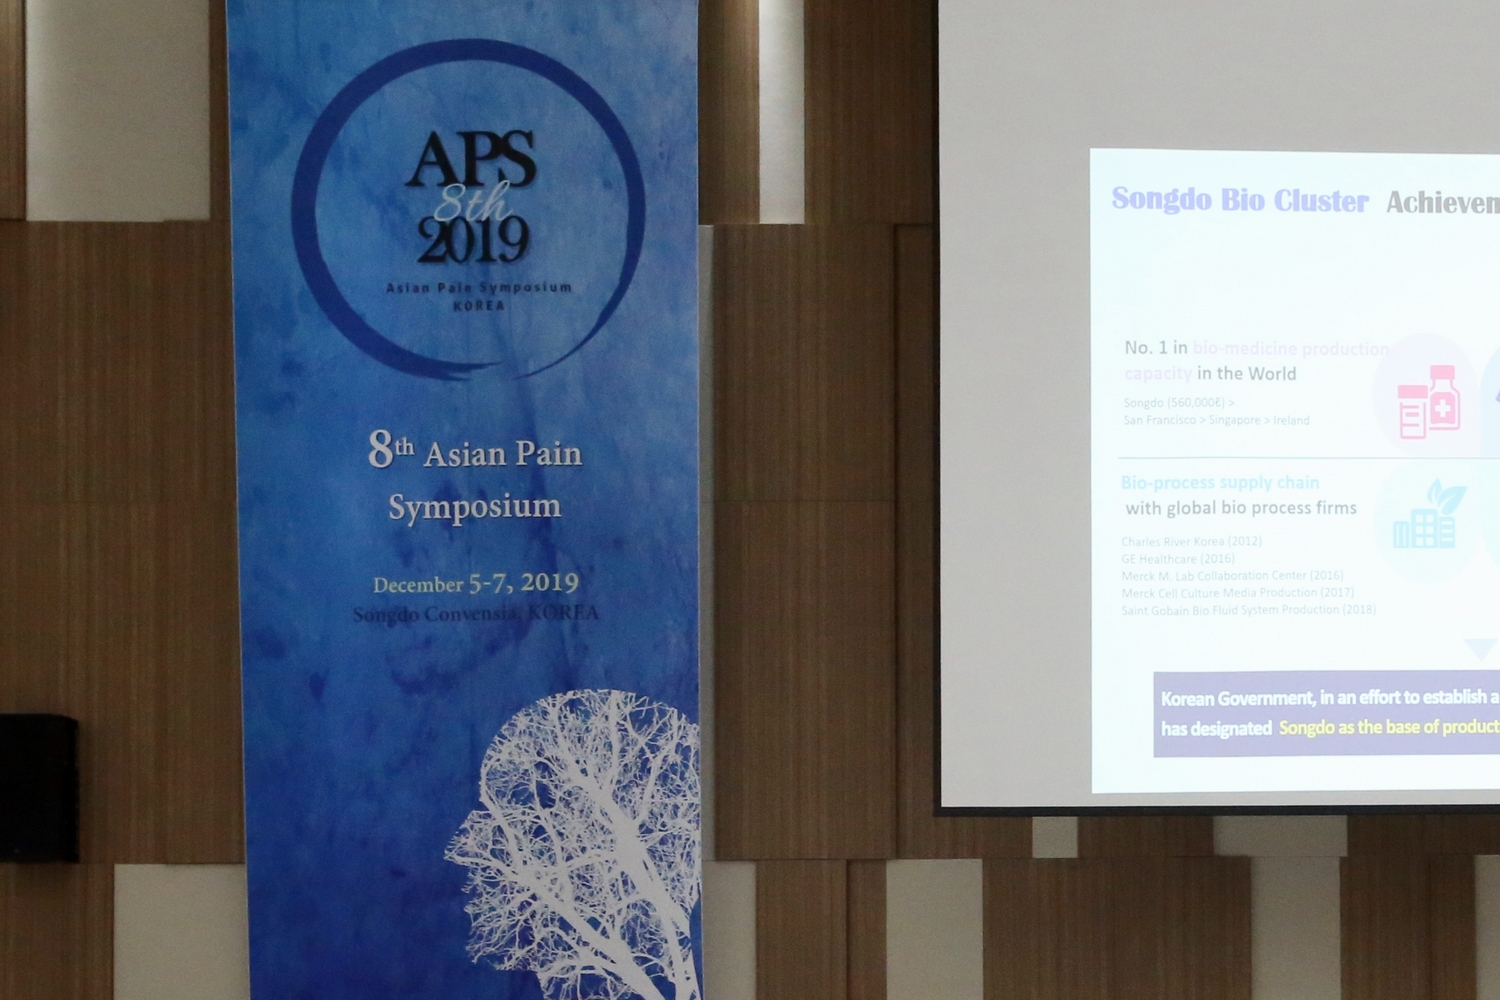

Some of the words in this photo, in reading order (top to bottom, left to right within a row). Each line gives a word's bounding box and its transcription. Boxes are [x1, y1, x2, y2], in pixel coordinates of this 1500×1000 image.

[405, 129, 537, 188] APS
[433, 180, 513, 222] 8th
[1112, 186, 1212, 215] Songdo
[1222, 188, 1265, 211] Bio
[1274, 188, 1370, 212] Cluster
[417, 215, 530, 264] 2019
[386, 282, 430, 294] Asian
[437, 282, 472, 294] Pain
[479, 281, 572, 297] Symposium
[453, 301, 506, 312] KOREA
[1125, 340, 1153, 355] No.
[1159, 339, 1168, 355] 1
[1173, 339, 1188, 355] in
[1193, 340, 1297, 355] bio-medicine
[1302, 342, 1390, 358] production
[1125, 365, 1192, 383] capacity
[1197, 364, 1212, 380] in
[1216, 364, 1244, 381] the
[1248, 366, 1298, 381] World
[368, 429, 415, 469] 8th
[423, 441, 506, 468] Asian
[516, 440, 583, 466] Pain
[1122, 475, 1215, 493] Bio-process
[1220, 475, 1272, 492] supply
[1277, 475, 1319, 489] chain
[389, 493, 563, 528] Symposium
[1126, 501, 1161, 515] with
[1167, 500, 1216, 519] global
[1222, 500, 1246, 514] bio
[1252, 504, 1311, 517] process
[1316, 500, 1357, 514] firms
[1121, 536, 1160, 547] Charles
[1164, 537, 1191, 547] River
[1194, 537, 1224, 546] Korea
[1228, 535, 1262, 548] (2012)
[374, 576, 464, 593] December
[469, 573, 513, 595] 5-7,
[521, 573, 579, 594] 2019
[353, 606, 420, 627] Songdo
[528, 604, 599, 621] KOREA
[1162, 691, 1215, 706] Korean
[1217, 690, 1317, 708] Government,
[1320, 689, 1334, 705] in
[1337, 693, 1356, 705] an
[1359, 689, 1401, 704] effort
[1403, 690, 1420, 704] to
[1423, 688, 1487, 704] establish
[1490, 692, 1499, 704] a
[1162, 721, 1188, 736] has
[1191, 720, 1272, 739] designated
[1279, 719, 1336, 739] Songdo
[1338, 723, 1355, 735] as
[1357, 719, 1384, 734] the
[1386, 718, 1422, 734] base
[1424, 718, 1441, 734] of
